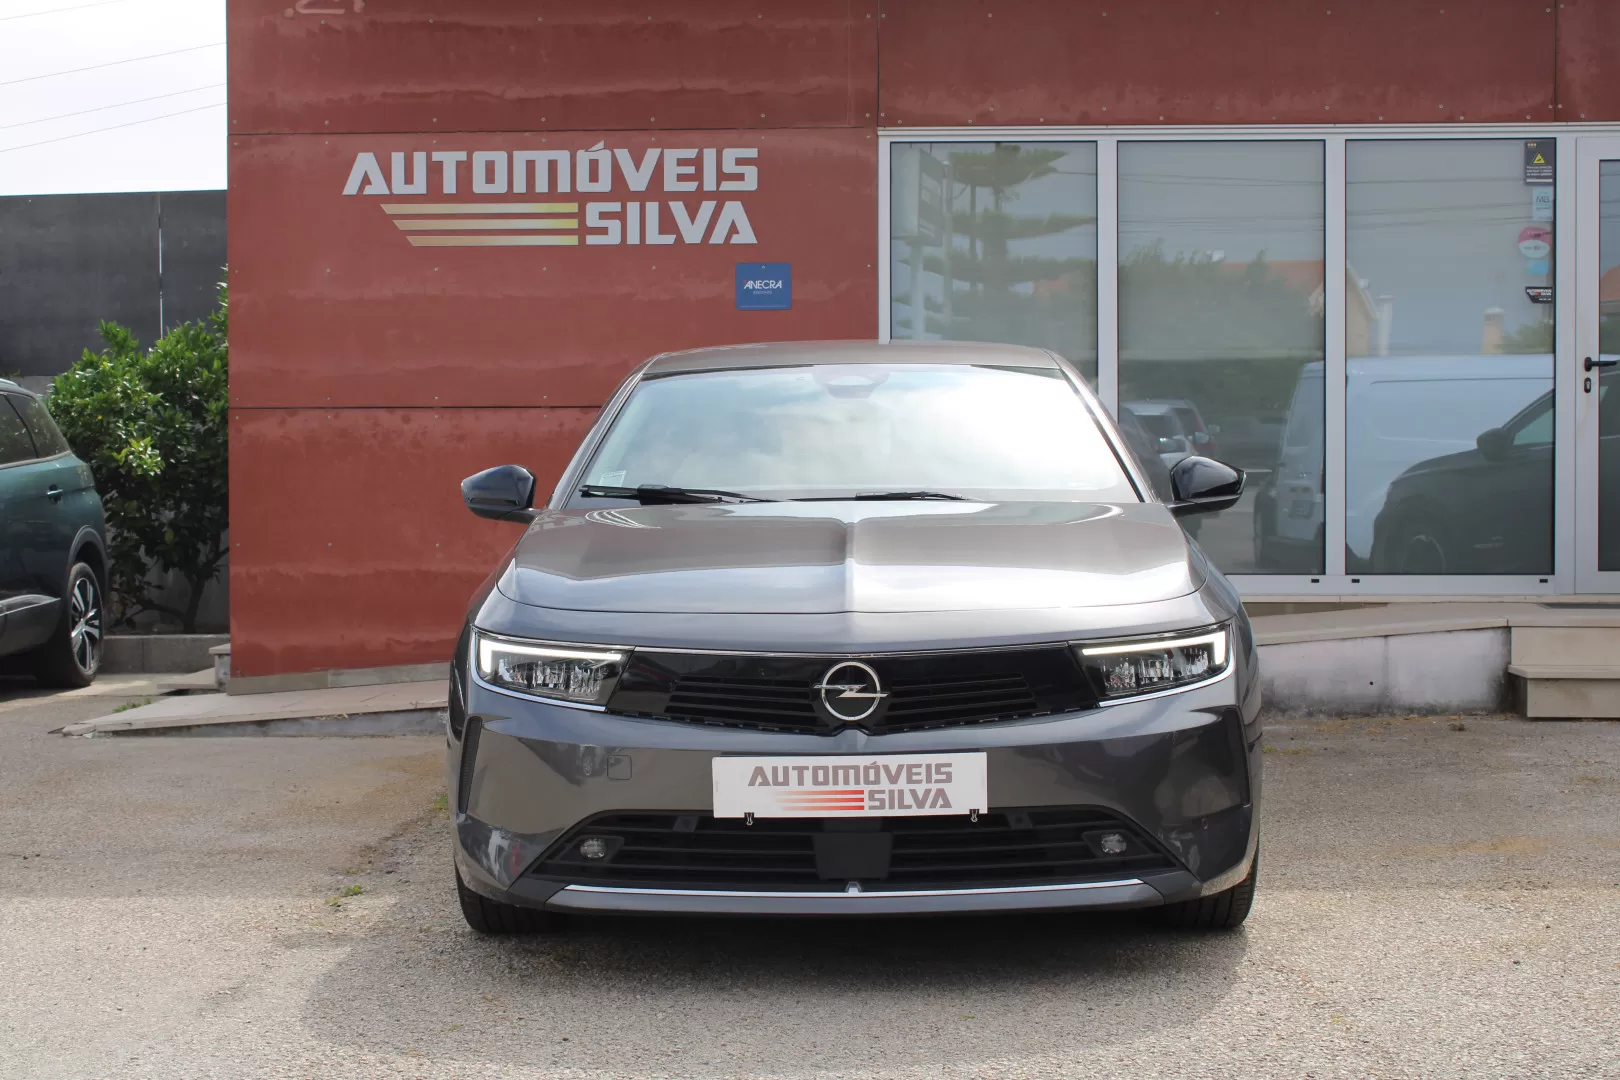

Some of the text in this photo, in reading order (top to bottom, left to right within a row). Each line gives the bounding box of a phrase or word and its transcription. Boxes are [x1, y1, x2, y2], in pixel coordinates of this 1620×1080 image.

[342, 141, 759, 196] AUTOMÓVEIS
[585, 201, 758, 245] SILVA
[743, 280, 783, 290] ANECRA
[748, 761, 953, 787] AUTOMÓVEIS
[868, 788, 953, 811] SILVA
